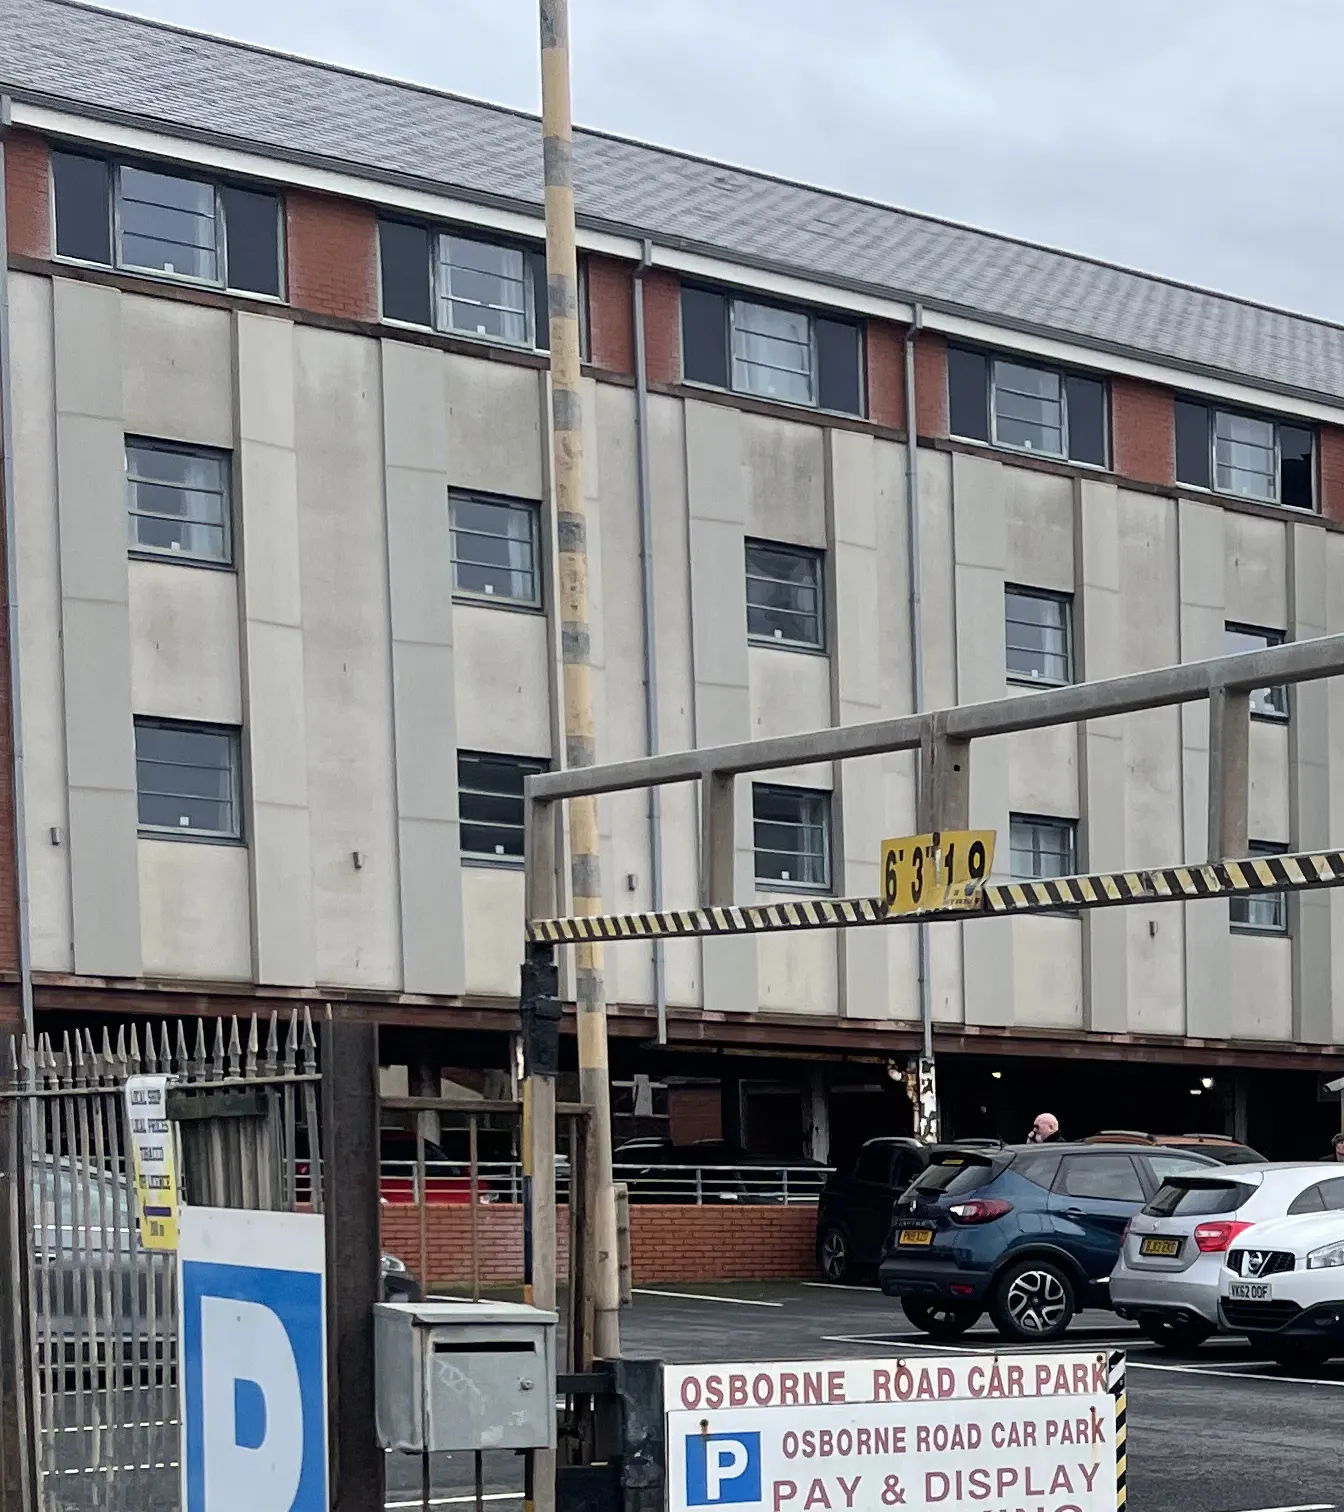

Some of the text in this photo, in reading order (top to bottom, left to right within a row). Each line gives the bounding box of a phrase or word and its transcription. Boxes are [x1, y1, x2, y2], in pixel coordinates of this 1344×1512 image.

[681, 1362, 1108, 1410] OSBORNE ROAD CAR PARK
[782, 1417, 1106, 1459] OSBORNE ROAD CAR PARK
[705, 1439, 747, 1500] P
[773, 1463, 1100, 1512] PAY & DISPLAY
